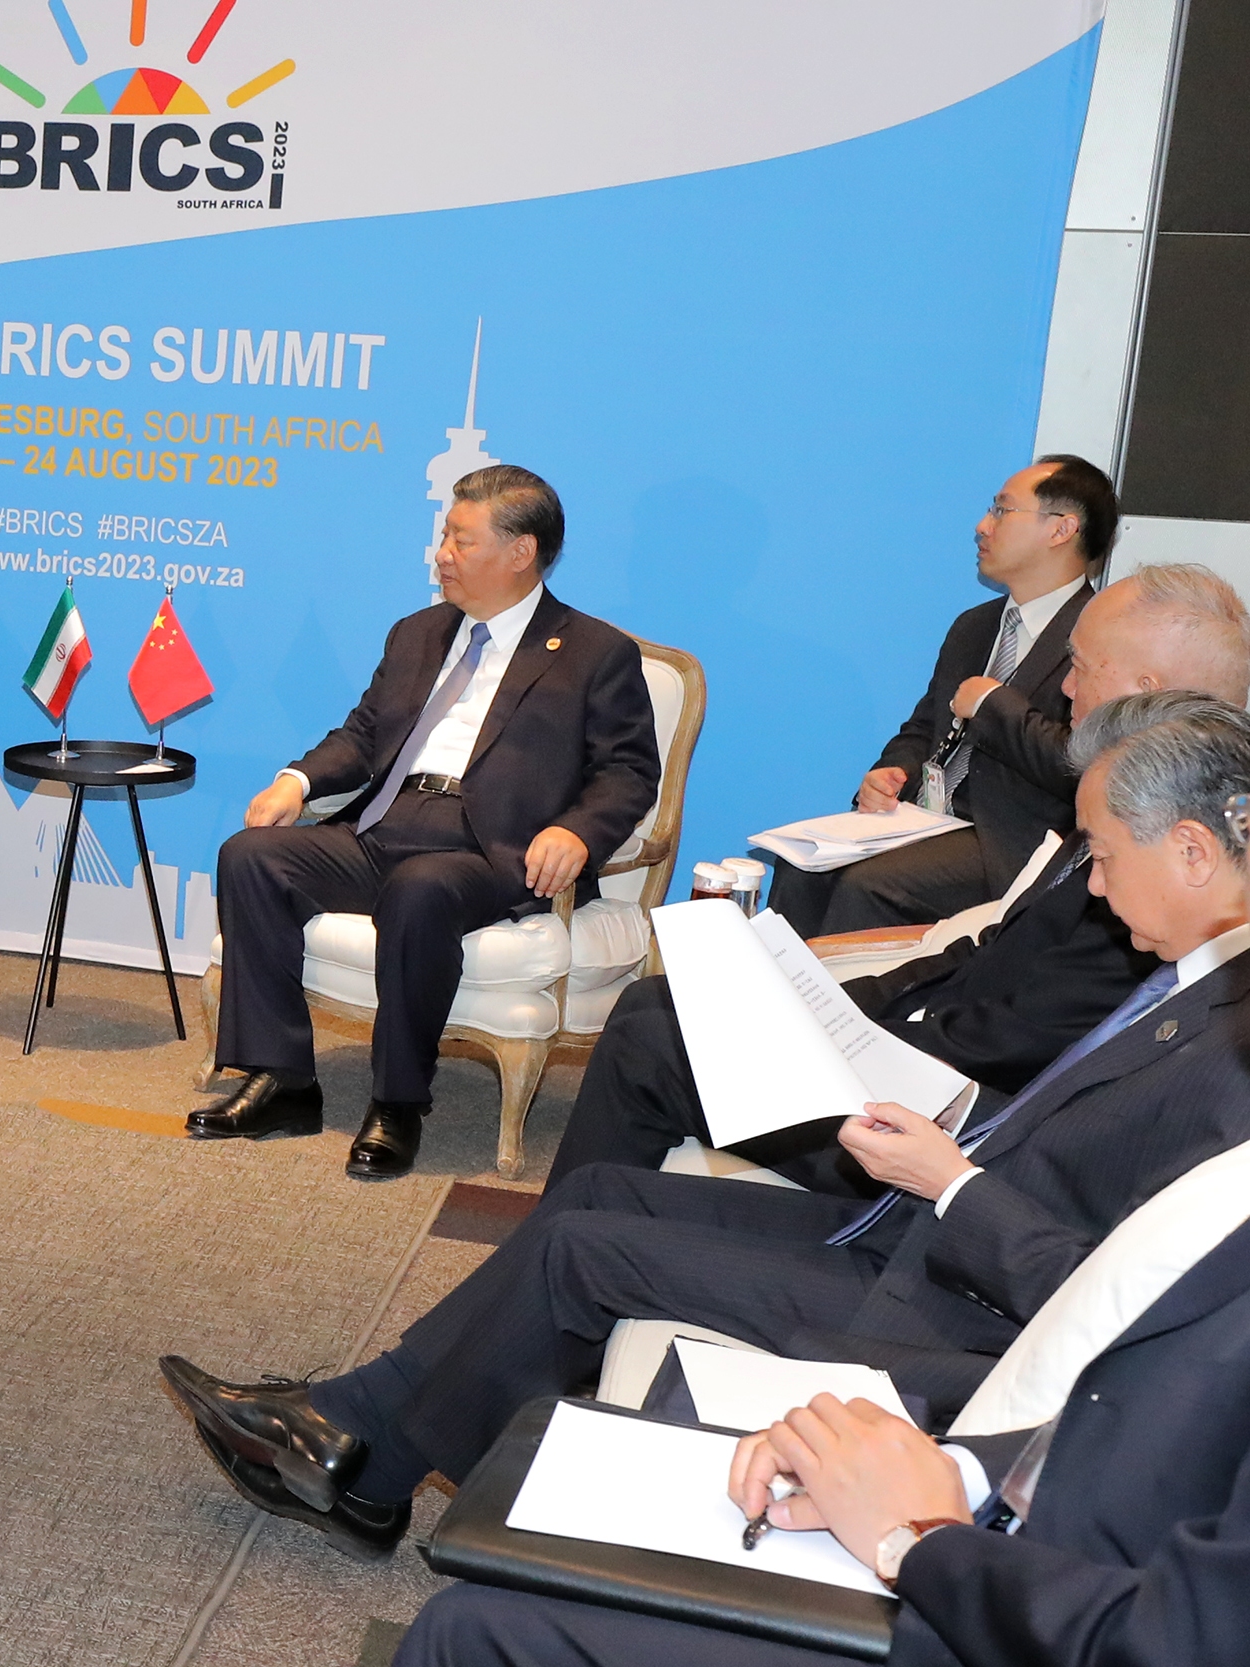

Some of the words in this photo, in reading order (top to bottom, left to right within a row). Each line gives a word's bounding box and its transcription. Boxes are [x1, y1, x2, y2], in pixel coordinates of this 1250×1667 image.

[271, 121, 289, 171] 2023
[176, 199, 218, 209] SOUTH
[220, 199, 264, 209] AFRICA
[149, 326, 386, 391] SUMMIT
[143, 410, 253, 446] SOUTH
[261, 416, 384, 453] AFRICA
[23, 445, 57, 475] 24
[64, 447, 199, 483] AUGUST
[207, 454, 279, 489] 2023
[97, 513, 228, 548] #BRICSZA
